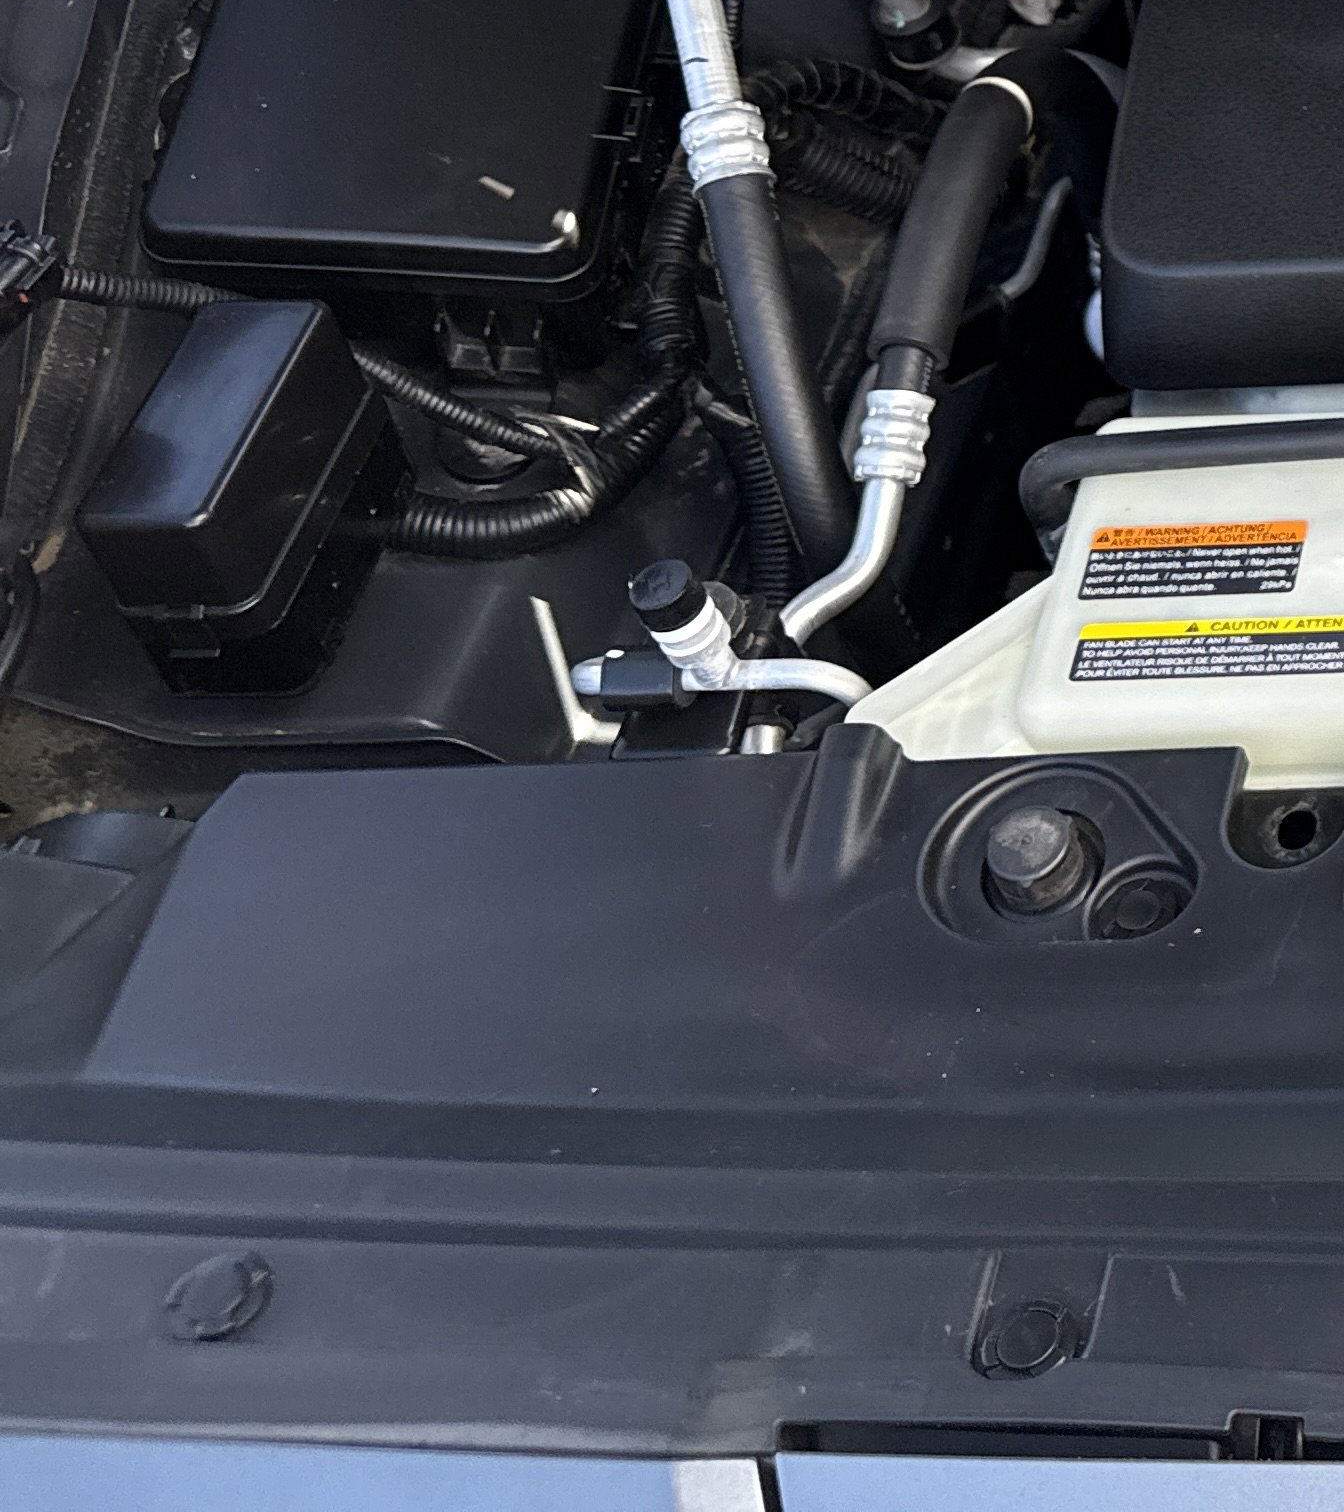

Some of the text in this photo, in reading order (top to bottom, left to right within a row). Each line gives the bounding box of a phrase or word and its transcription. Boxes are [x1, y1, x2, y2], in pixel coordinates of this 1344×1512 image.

[1145, 527, 1200, 536] WARNING
[1207, 524, 1265, 534] ACHTUNG
[1110, 535, 1207, 546] AVERTISSEMENT
[1192, 548, 1222, 556] Never
[1222, 548, 1248, 557] open
[1248, 546, 1275, 555] when
[1082, 586, 1116, 596] Nunca
[1210, 620, 1278, 632] CAUTION
[1083, 640, 1103, 648] FAN
[1104, 640, 1138, 648] BLADE
[1161, 638, 1192, 646] START
[1192, 637, 1206, 645] AT
[1206, 636, 1228, 644] ANY
[1082, 650, 1096, 658] TO
[1096, 649, 1124, 658] HELP
[1122, 648, 1154, 656] AVOID
[1155, 646, 1206, 655] PERSONAL
[1268, 642, 1304, 652] HANDS
[1092, 658, 1156, 668] VENTILATEUR
[1156, 657, 1194, 666] RISQUE
[1195, 656, 1210, 664] DE
[1276, 653, 1301, 662] TOUT
[1075, 669, 1106, 678] POUR
[1141, 667, 1172, 676] TOUTE
[1229, 664, 1244, 672] NE
[1244, 664, 1266, 672] PAS
[1265, 662, 1280, 672] EN
[1281, 661, 1344, 672] APPROCHER
